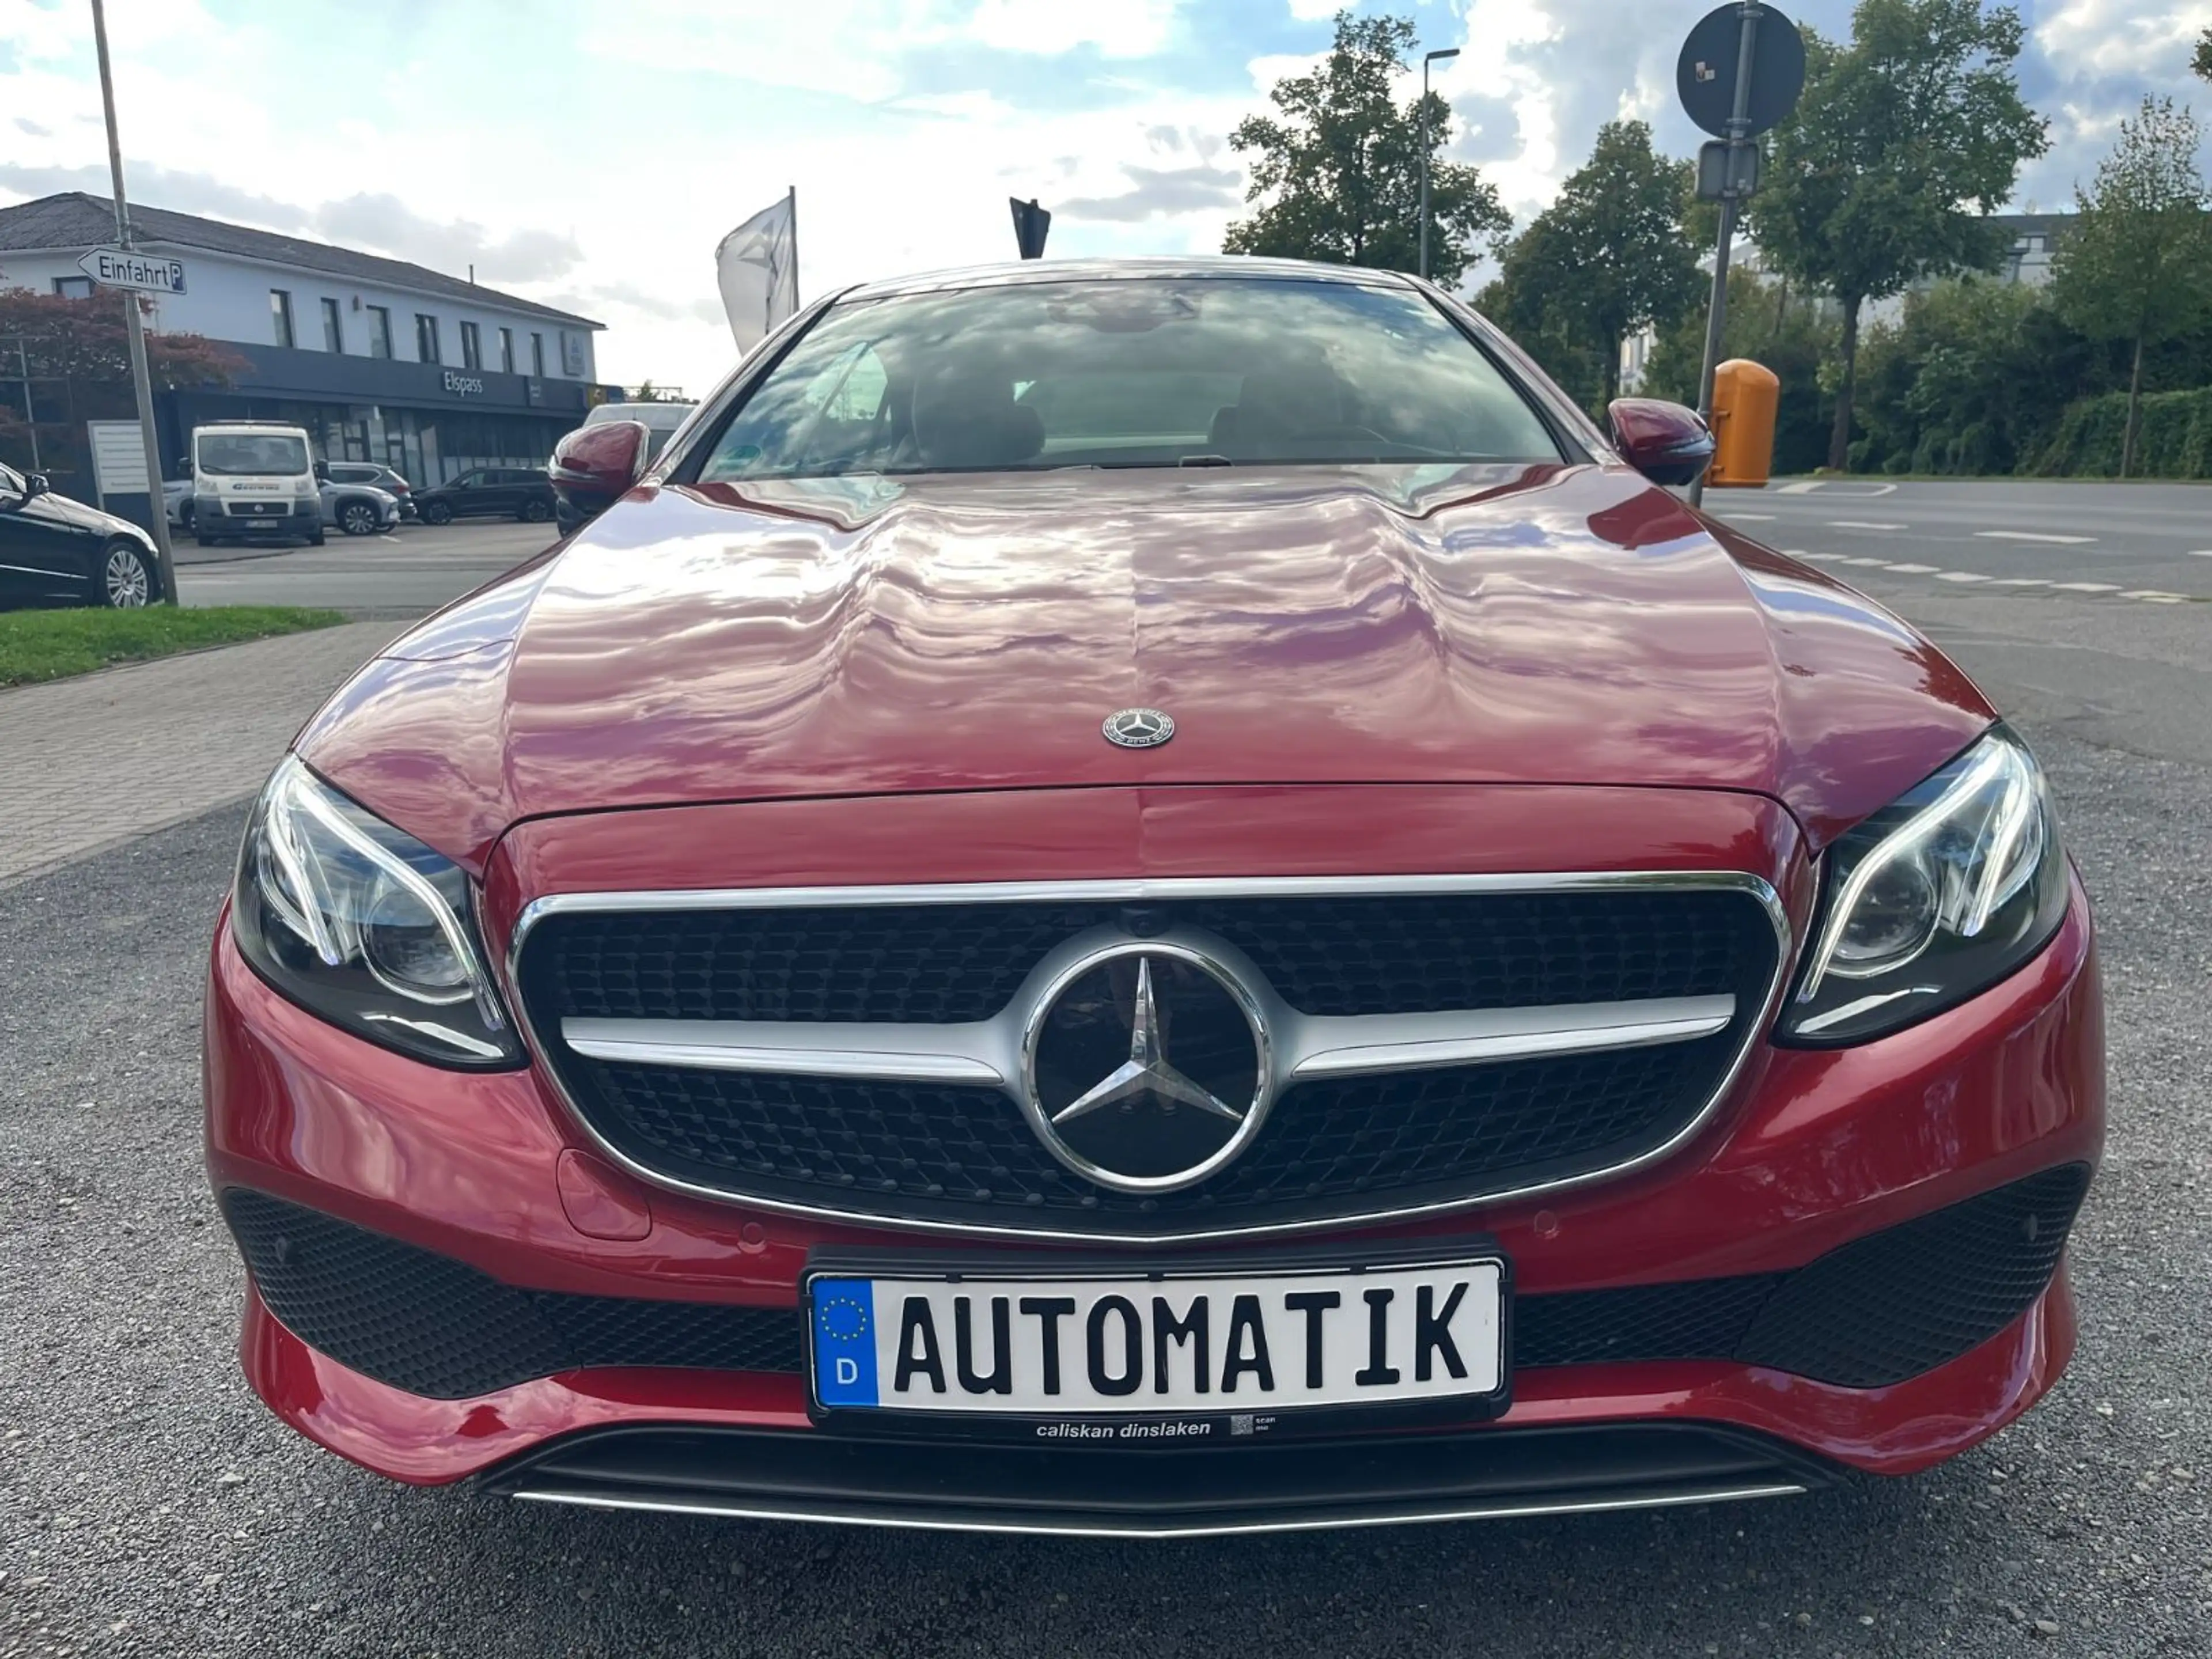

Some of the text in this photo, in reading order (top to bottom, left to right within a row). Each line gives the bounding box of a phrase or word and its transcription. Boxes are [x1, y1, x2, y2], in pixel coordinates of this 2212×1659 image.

[99, 256, 168, 286] Einfahrt
[445, 370, 483, 397] Elspass
[894, 1282, 1469, 1396] AUTOMATIK
[836, 1358, 858, 1385] D
[1036, 1422, 1211, 1438] caliskan dinslaken
